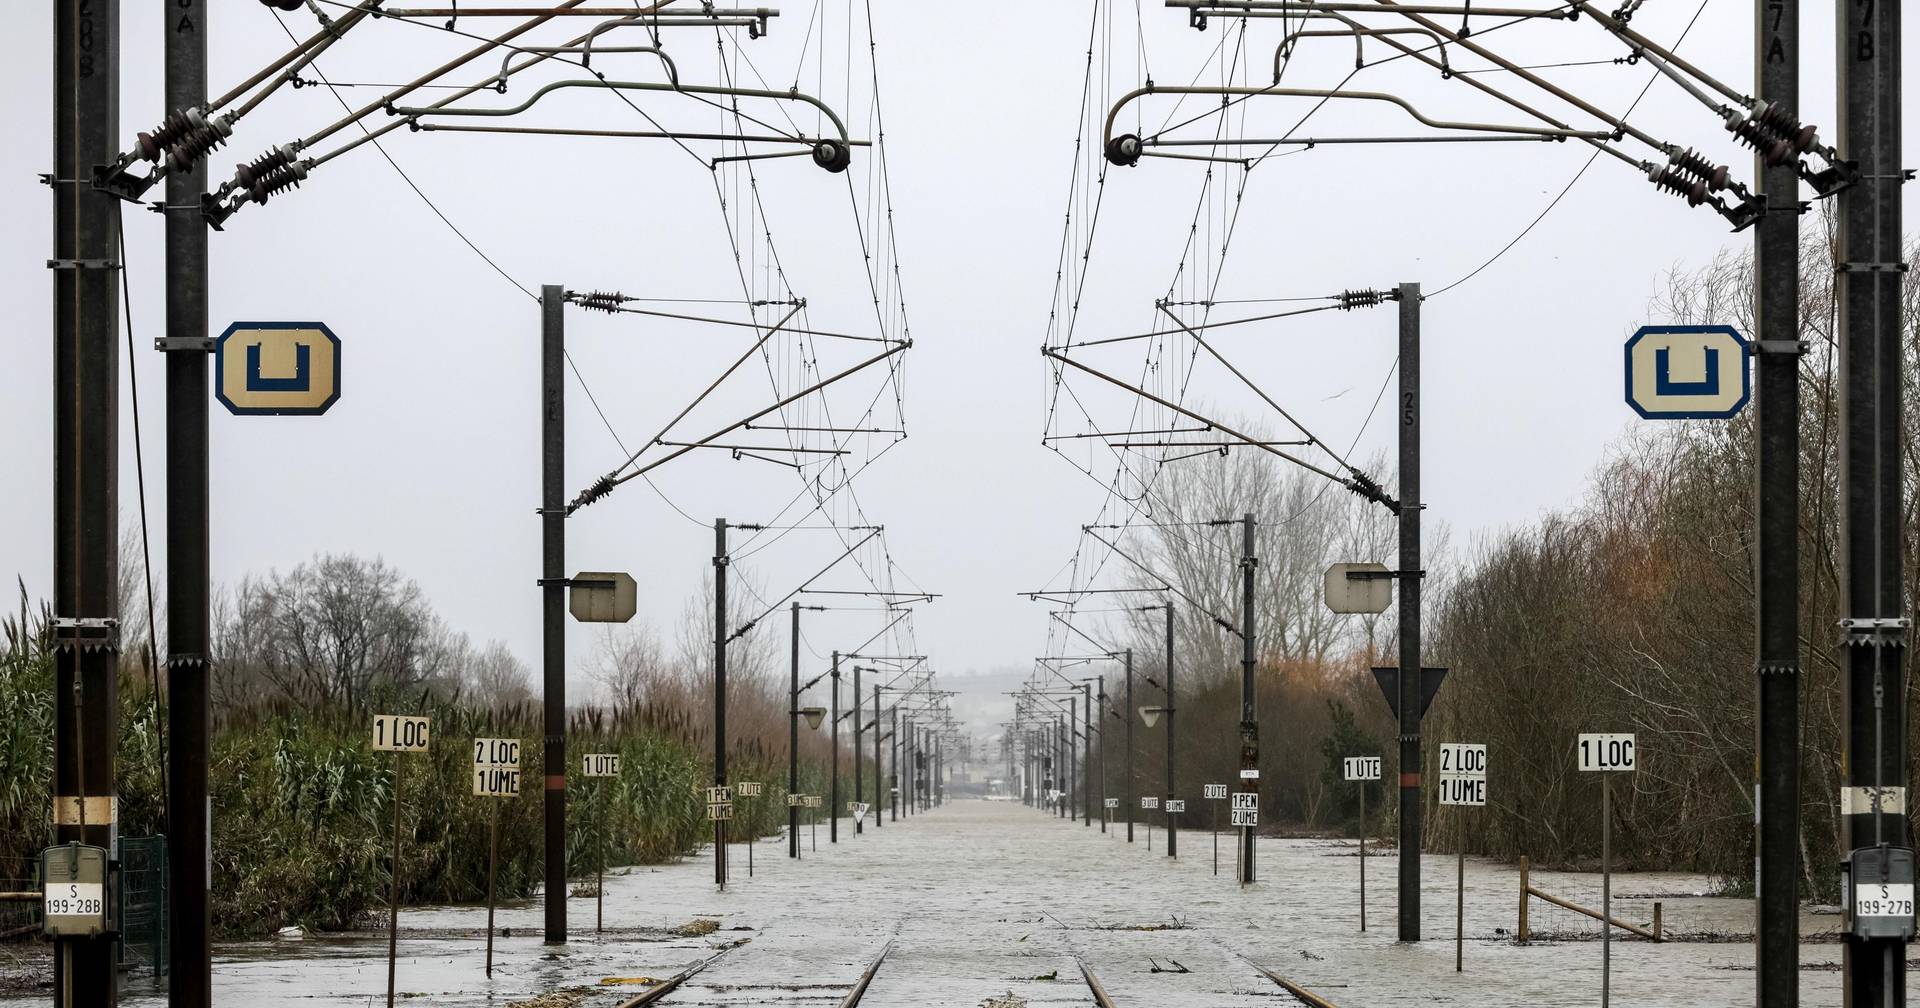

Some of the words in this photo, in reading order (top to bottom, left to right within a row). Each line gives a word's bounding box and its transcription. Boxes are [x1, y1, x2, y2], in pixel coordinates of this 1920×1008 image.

[1404, 392, 1414, 426] 25
[376, 719, 384, 746] 1
[392, 719, 427, 748] LOC
[475, 741, 484, 764] 2
[490, 741, 519, 765] LOC
[1442, 749, 1450, 771] 2
[1456, 748, 1485, 772] LOC
[1581, 740, 1589, 766] 1
[1598, 740, 1633, 767] LOC
[585, 756, 591, 774] 1
[596, 756, 619, 774] UTE
[1346, 760, 1351, 778] 1
[1356, 760, 1380, 778] UTE
[478, 771, 485, 793] 1
[488, 771, 519, 794] UME
[740, 783, 745, 794] 2
[747, 783, 761, 795] UTE
[707, 789, 712, 802] 1
[715, 788, 732, 802] PEN
[1204, 785, 1210, 796] 2
[1211, 785, 1226, 797] UTE
[1441, 779, 1448, 802] 1
[1452, 779, 1485, 802] UME
[1167, 801, 1171, 811] 3
[1172, 801, 1184, 811] UME
[1233, 795, 1238, 808] 1
[1239, 794, 1257, 808] PEN
[708, 805, 714, 818] 2
[715, 805, 732, 818] UME
[1233, 811, 1238, 824] 2
[1239, 811, 1257, 824] UME
[70, 885, 77, 898] S
[1881, 885, 1889, 899] S
[47, 899, 101, 913] 199-28B
[1858, 900, 1912, 914] 199-27B
